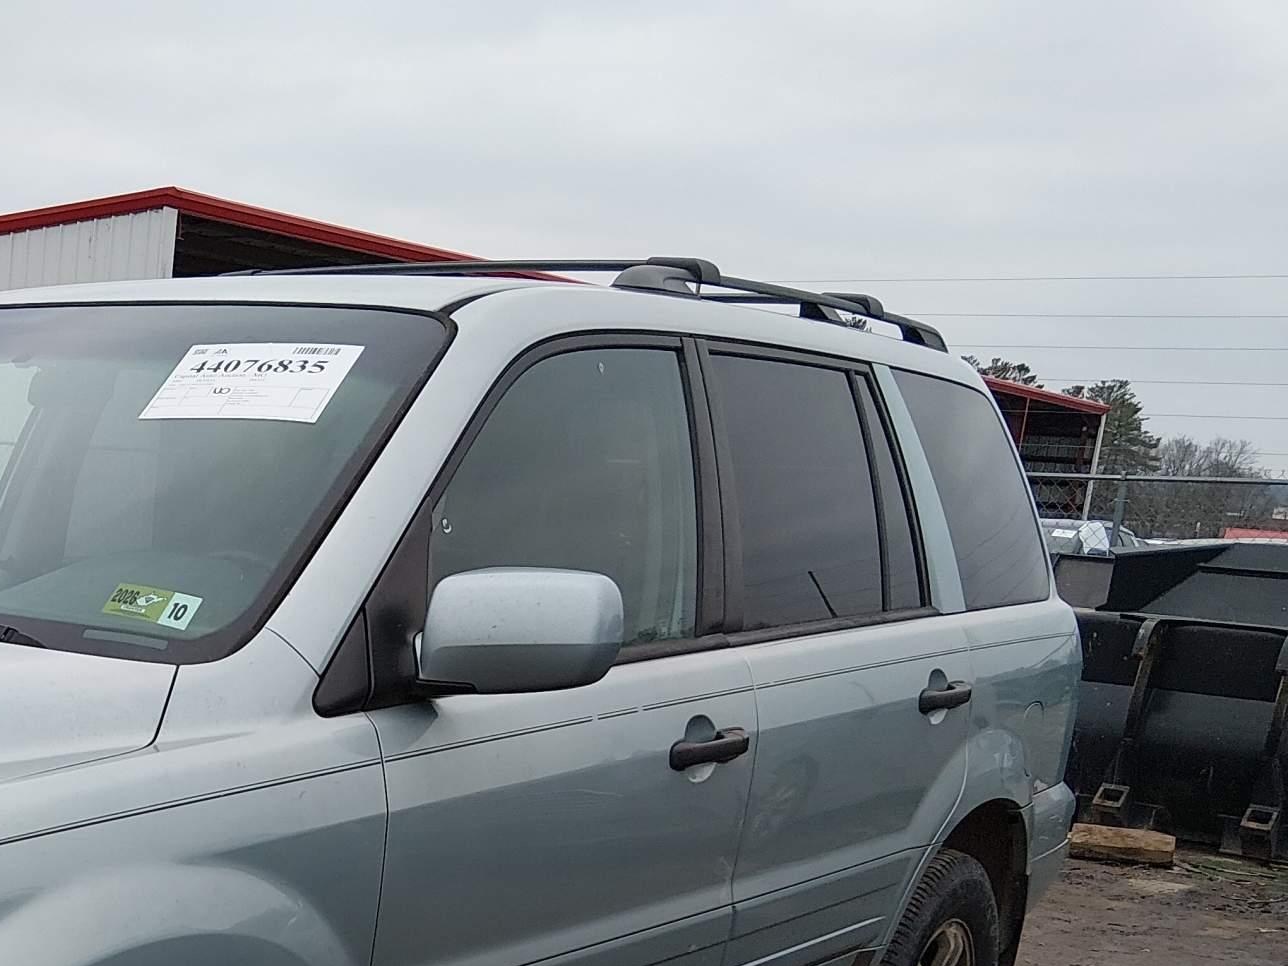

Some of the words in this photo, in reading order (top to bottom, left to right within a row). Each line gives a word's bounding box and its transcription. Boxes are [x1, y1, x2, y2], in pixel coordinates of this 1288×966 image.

[190, 359, 330, 374] 44076835
[110, 588, 140, 605] 2026
[168, 602, 188, 621] 10
